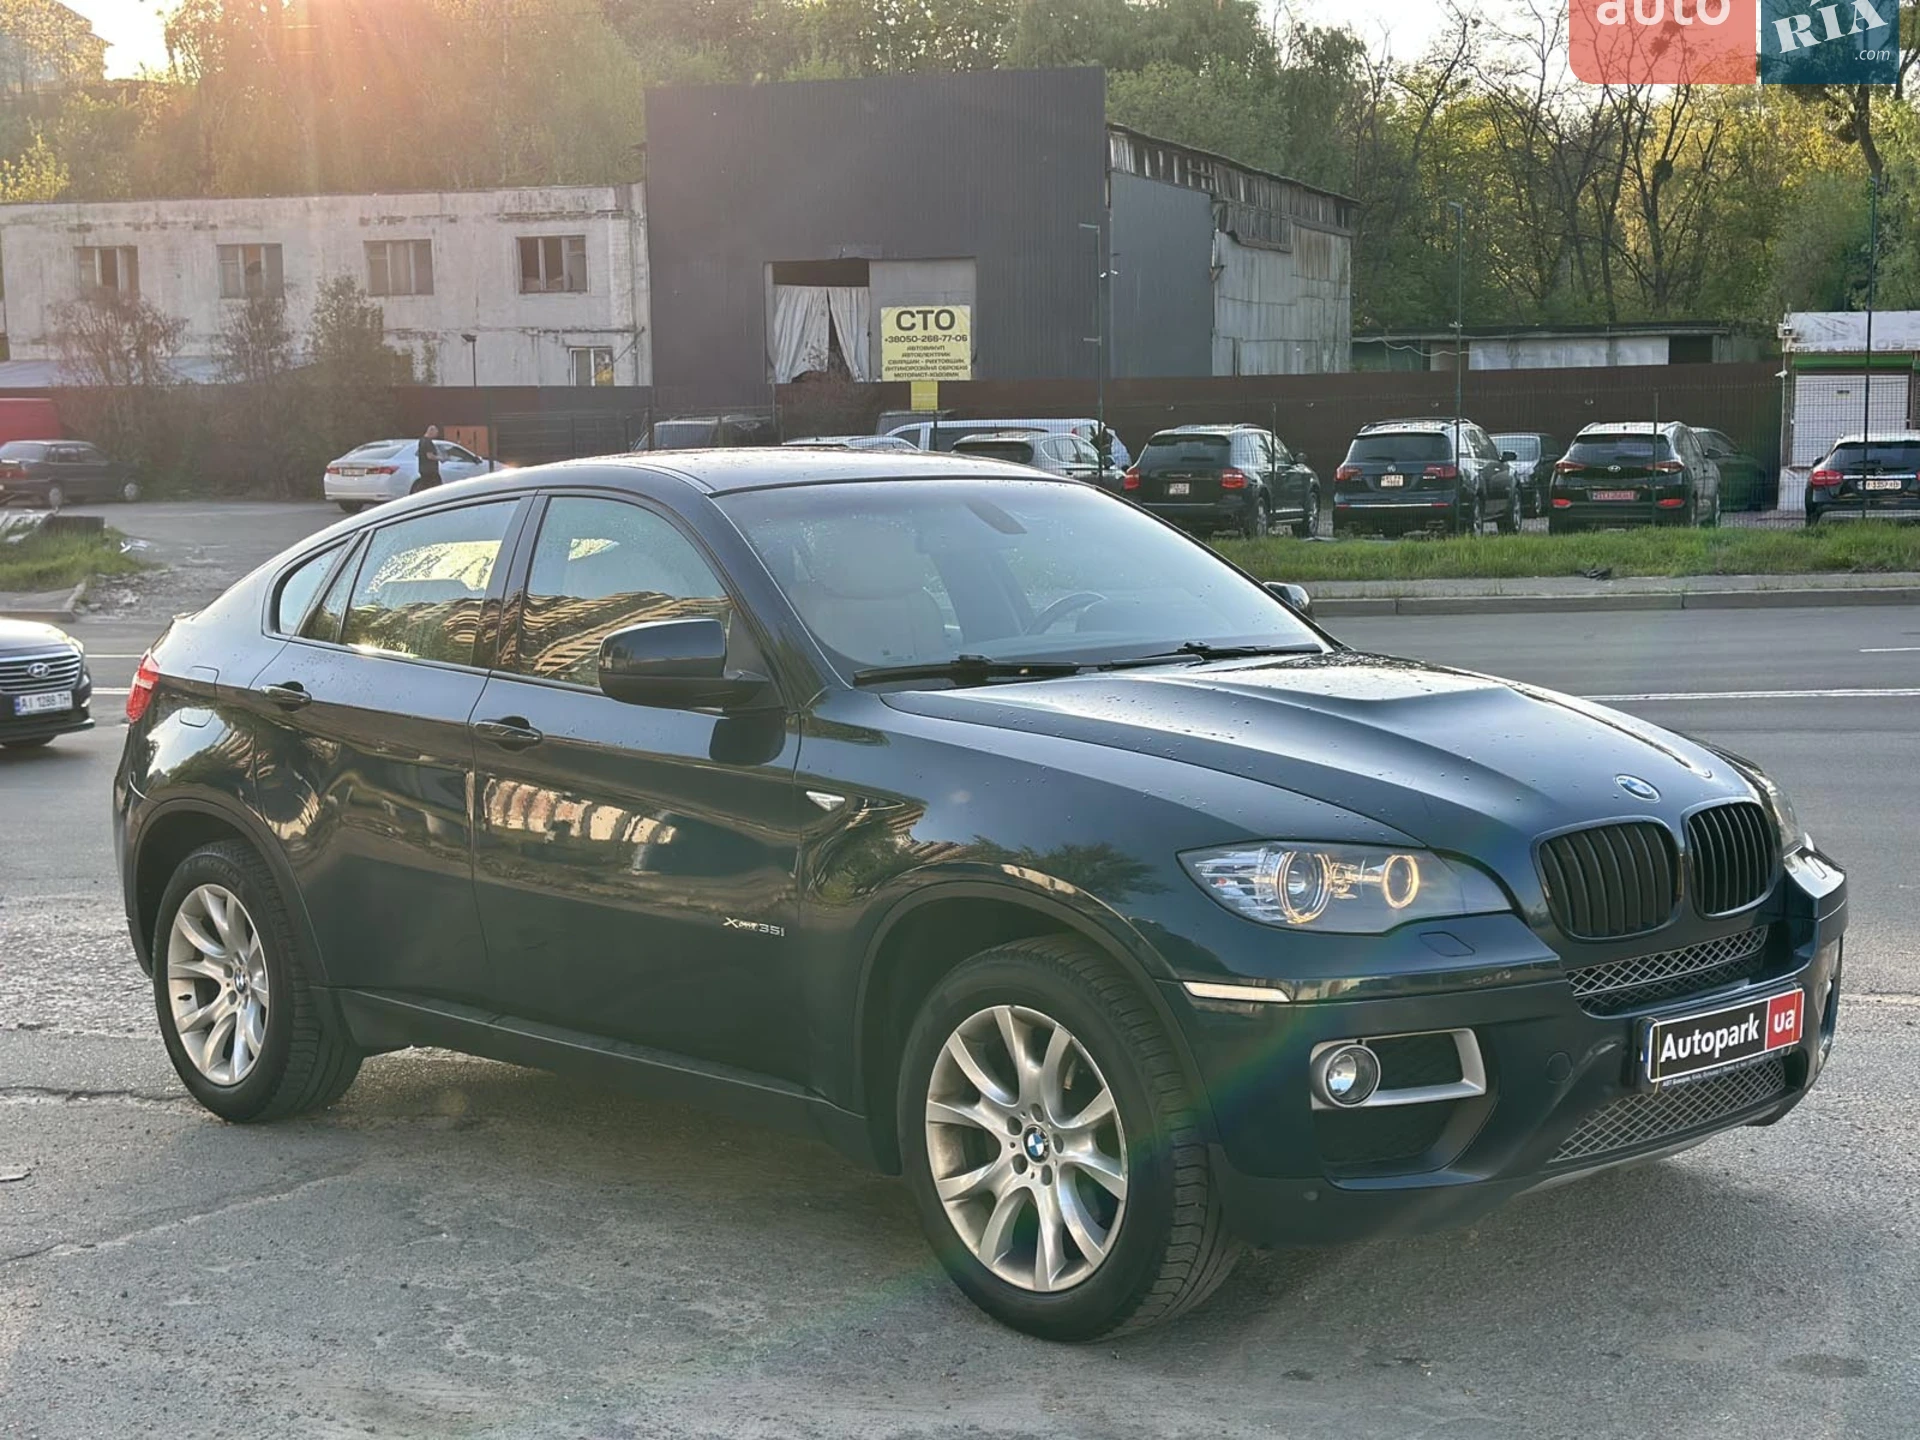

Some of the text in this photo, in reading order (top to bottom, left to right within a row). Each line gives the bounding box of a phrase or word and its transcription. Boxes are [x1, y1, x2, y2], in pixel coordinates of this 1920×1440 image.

[896, 309, 955, 331] СТО
[1660, 1008, 1796, 1062] Autopark ua
